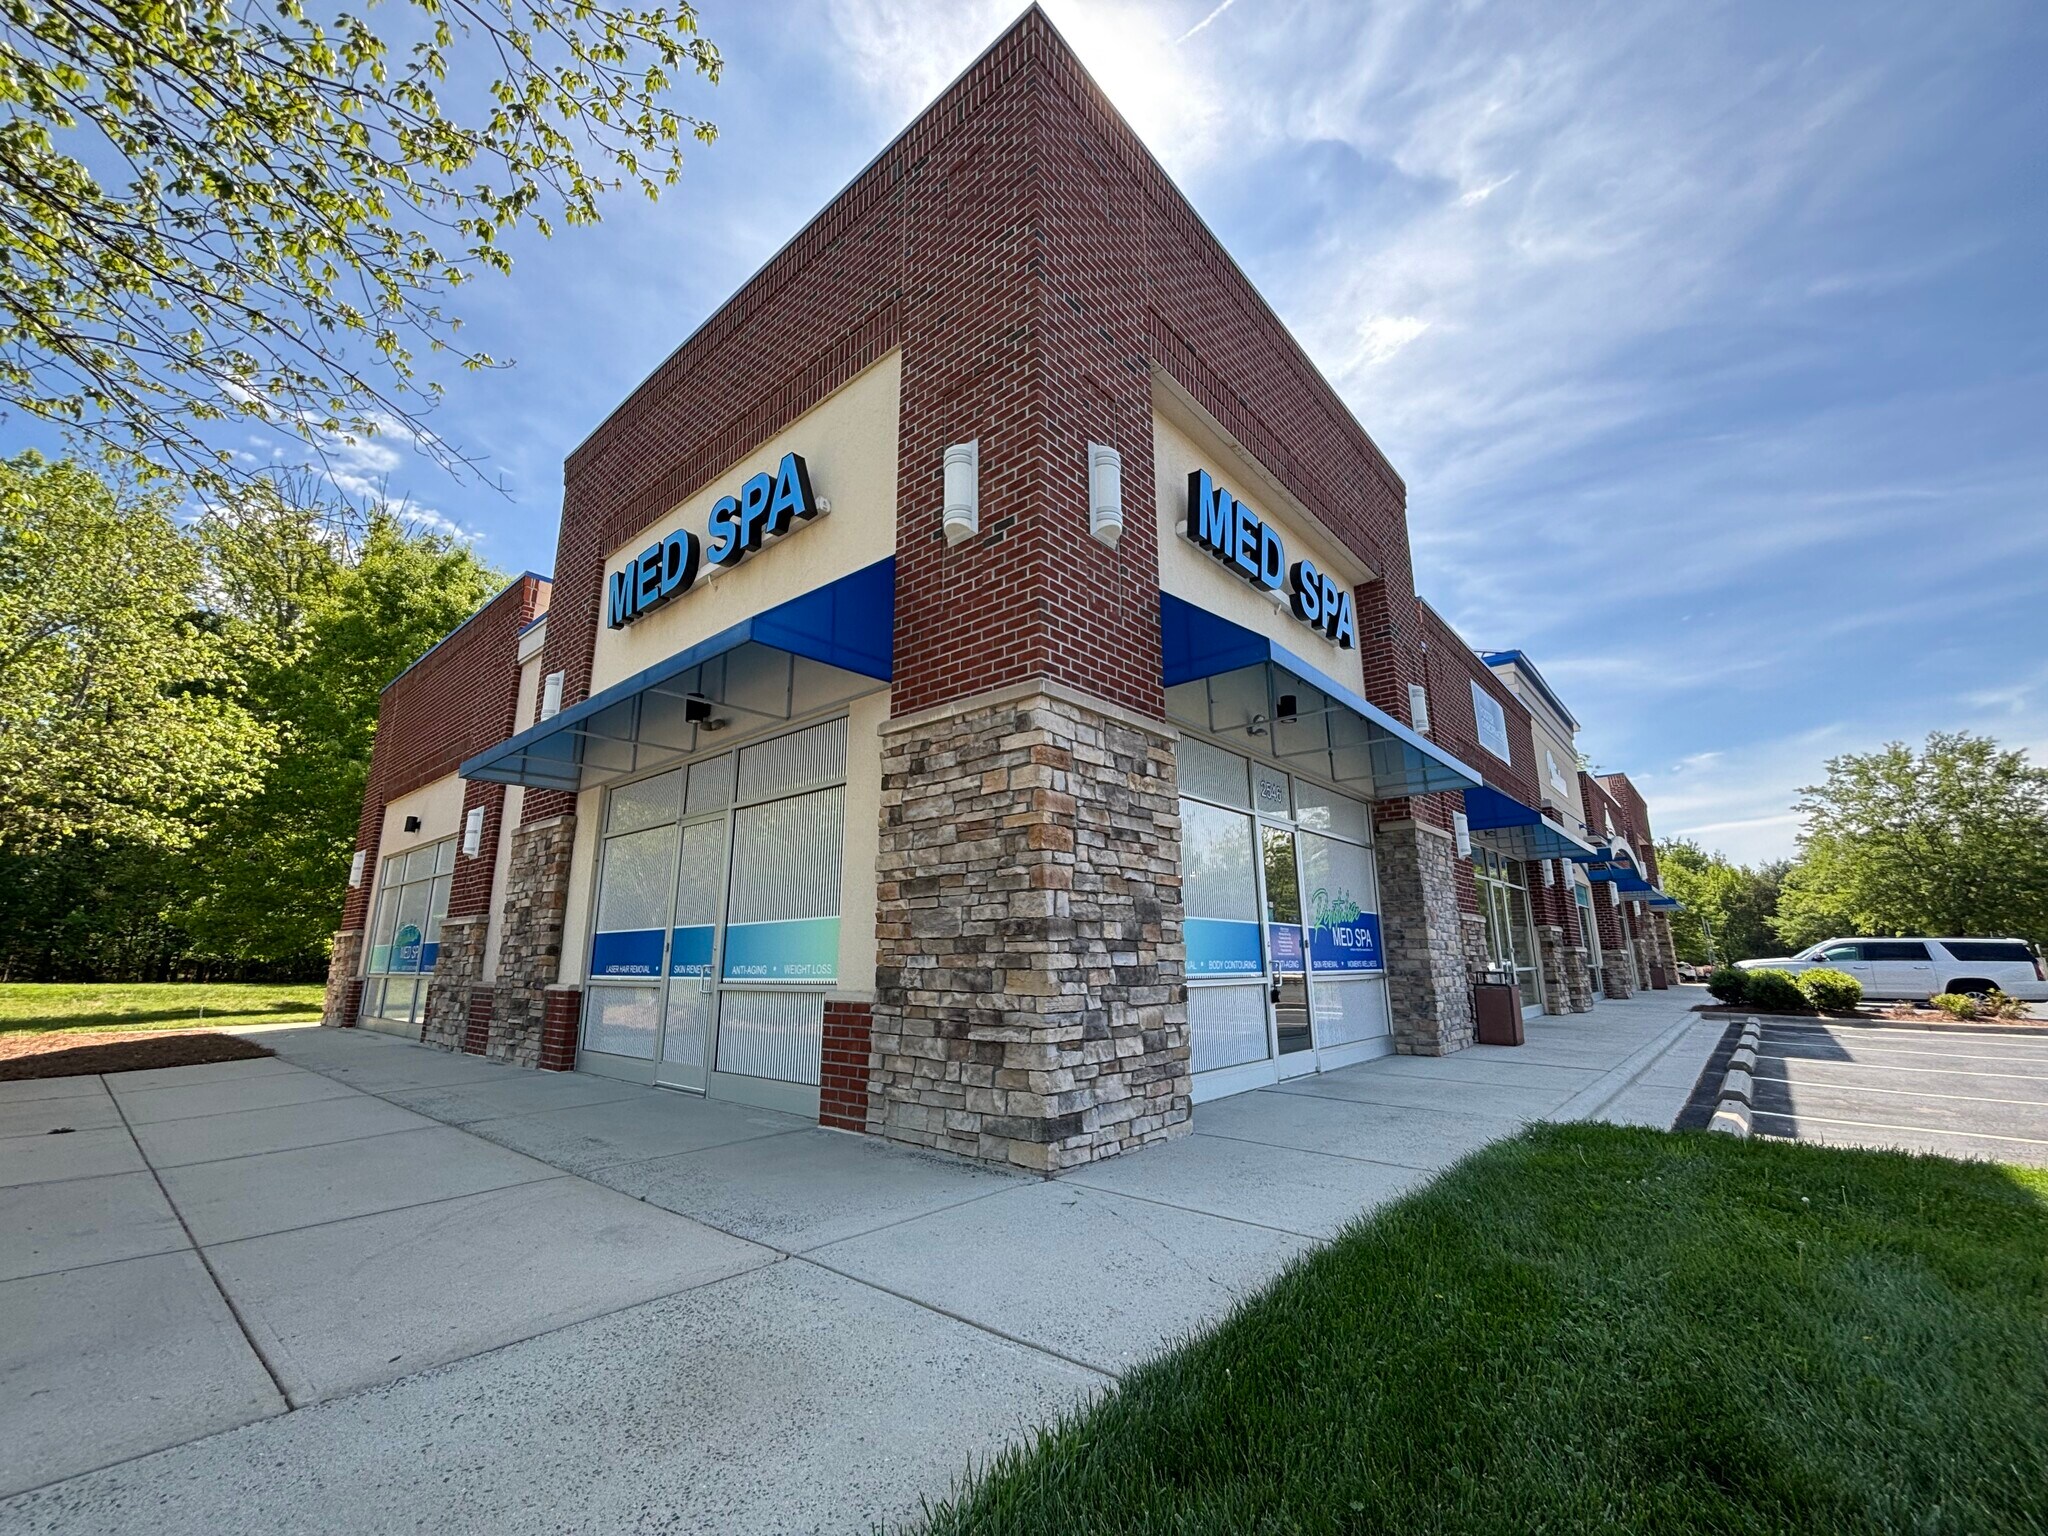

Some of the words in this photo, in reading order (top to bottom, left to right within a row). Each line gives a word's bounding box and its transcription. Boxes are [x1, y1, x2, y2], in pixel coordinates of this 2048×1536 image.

[607, 528, 697, 630] MED
[706, 452, 812, 566] SPA
[1194, 468, 1286, 592] MED
[1294, 558, 1356, 650] SPA
[1260, 779, 1283, 804] 2546
[1332, 926, 1354, 947] MED
[1354, 928, 1373, 948] SPA
[674, 964, 686, 974] SKIN
[731, 965, 767, 975] ANTI-AGING
[784, 964, 811, 975] WEIGHT
[812, 964, 832, 975] LOSS
[1208, 960, 1224, 970] BODY
[1224, 960, 1257, 970] CONTOURING
